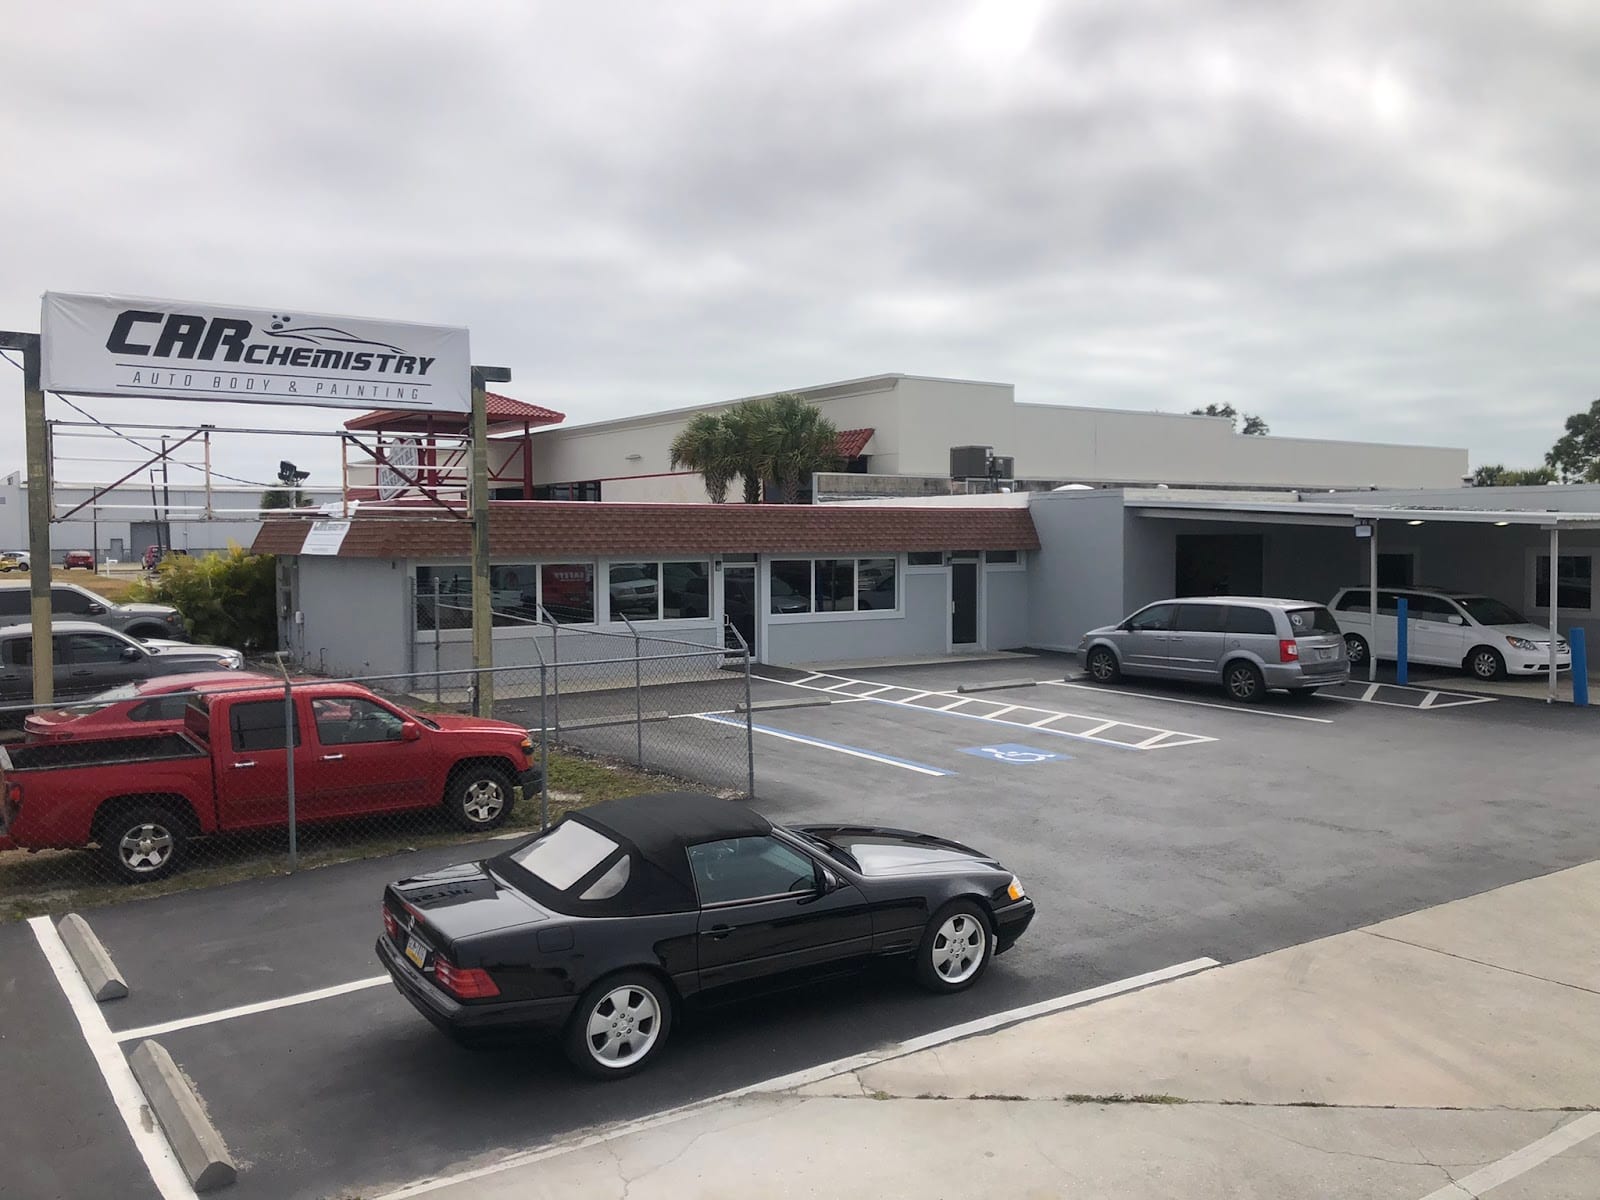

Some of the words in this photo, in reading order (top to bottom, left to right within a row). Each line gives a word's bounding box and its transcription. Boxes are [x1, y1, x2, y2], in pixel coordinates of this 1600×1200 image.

[106, 310, 253, 362] CAR
[243, 344, 435, 375] CHEMISTRY
[133, 371, 192, 387] AUTO
[213, 376, 270, 391] BODY
[289, 381, 298, 392] &
[316, 382, 418, 399] PAINTING
